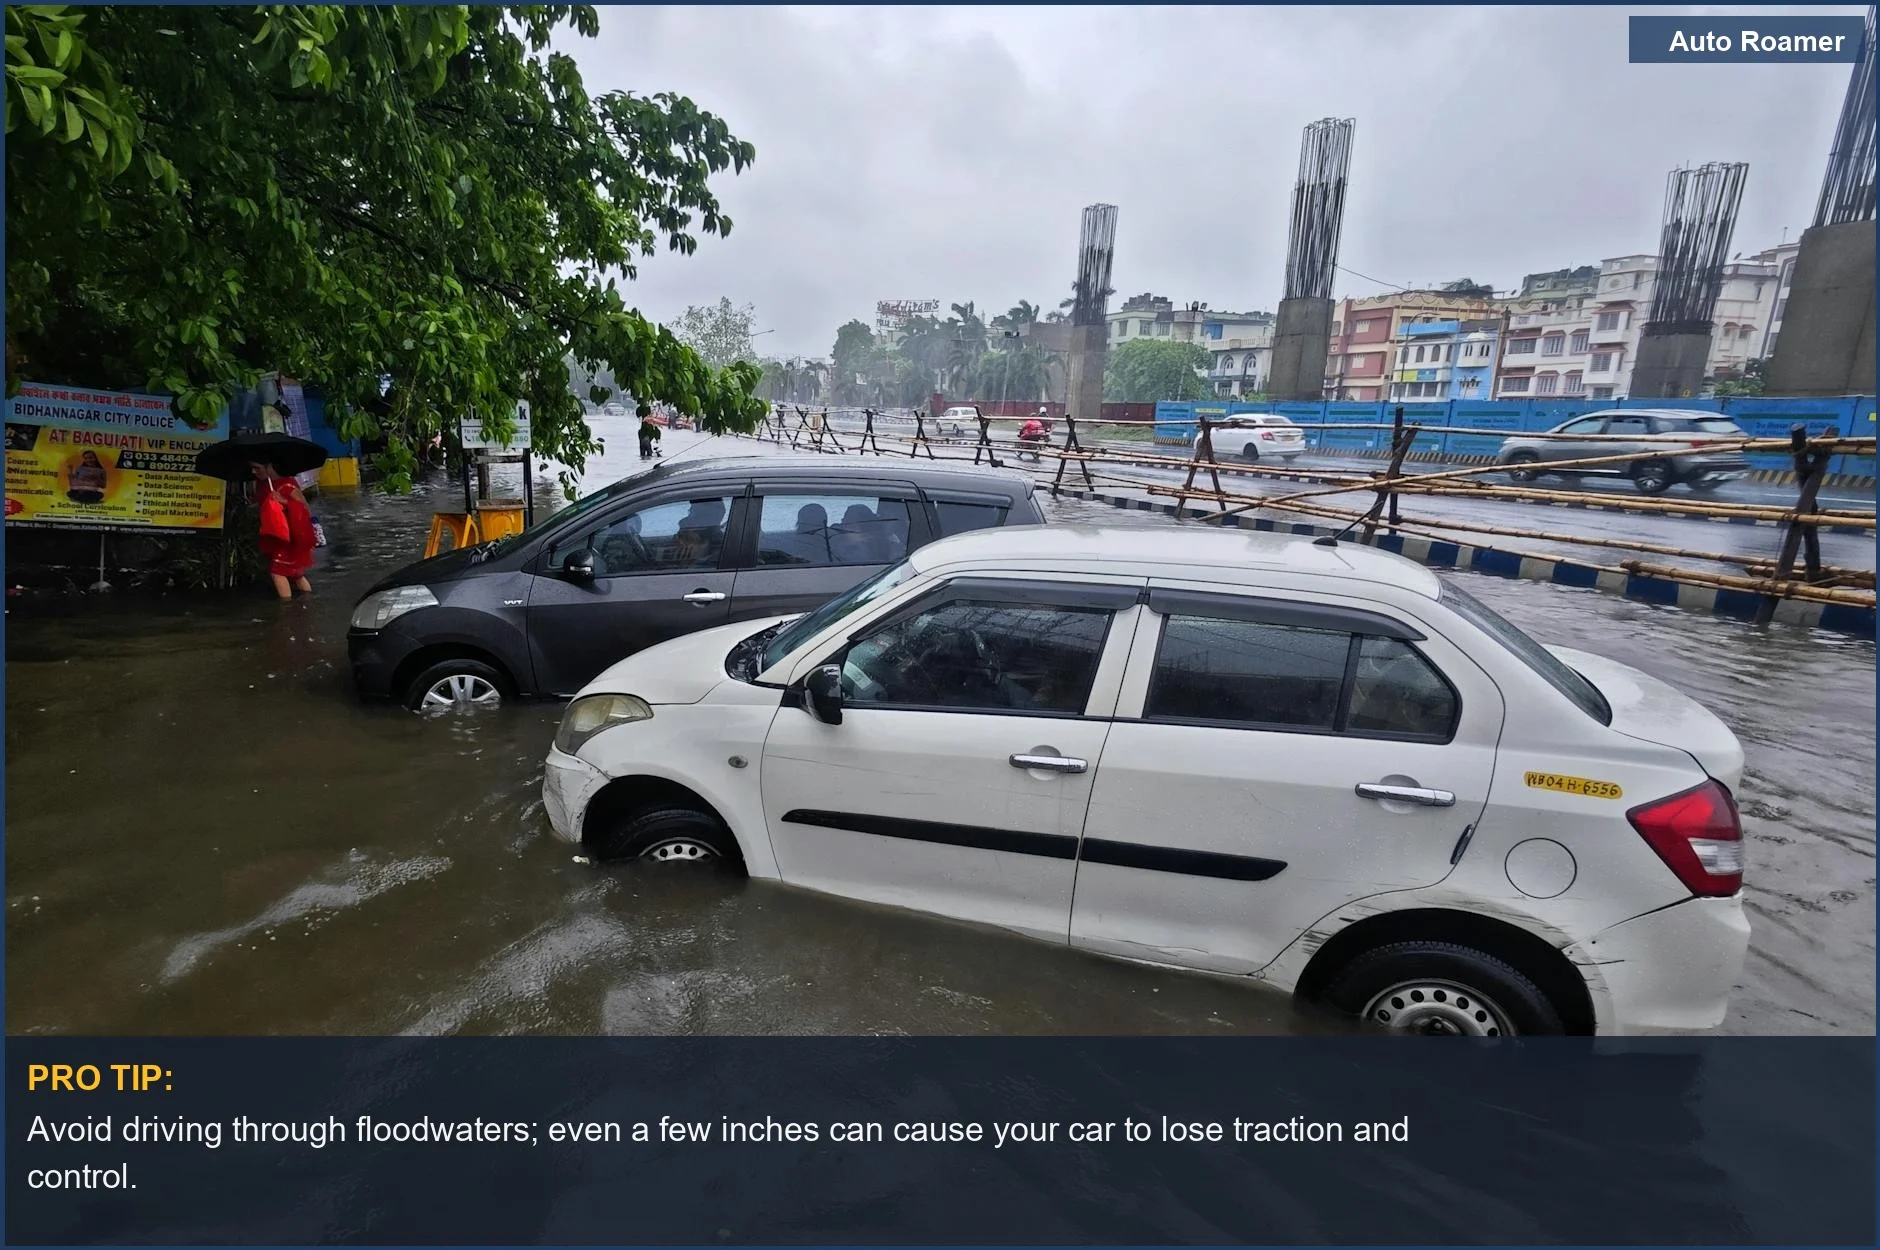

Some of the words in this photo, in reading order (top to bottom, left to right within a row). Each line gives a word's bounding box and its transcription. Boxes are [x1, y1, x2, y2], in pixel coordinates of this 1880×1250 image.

[14, 403, 101, 421] BIDHANNAGAR
[104, 411, 131, 425] CITY
[134, 414, 174, 428] POLICE
[49, 429, 68, 443] AT
[73, 431, 142, 449] BAGUIATI
[147, 438, 165, 449] VIP
[134, 452, 157, 461] 033
[144, 482, 162, 490] Data
[163, 482, 194, 491] Science
[57, 502, 83, 510] School
[143, 499, 170, 507] Ethical
[171, 501, 202, 509] Hacking
[142, 508, 167, 516] Digital
[169, 509, 209, 518] Marketing
